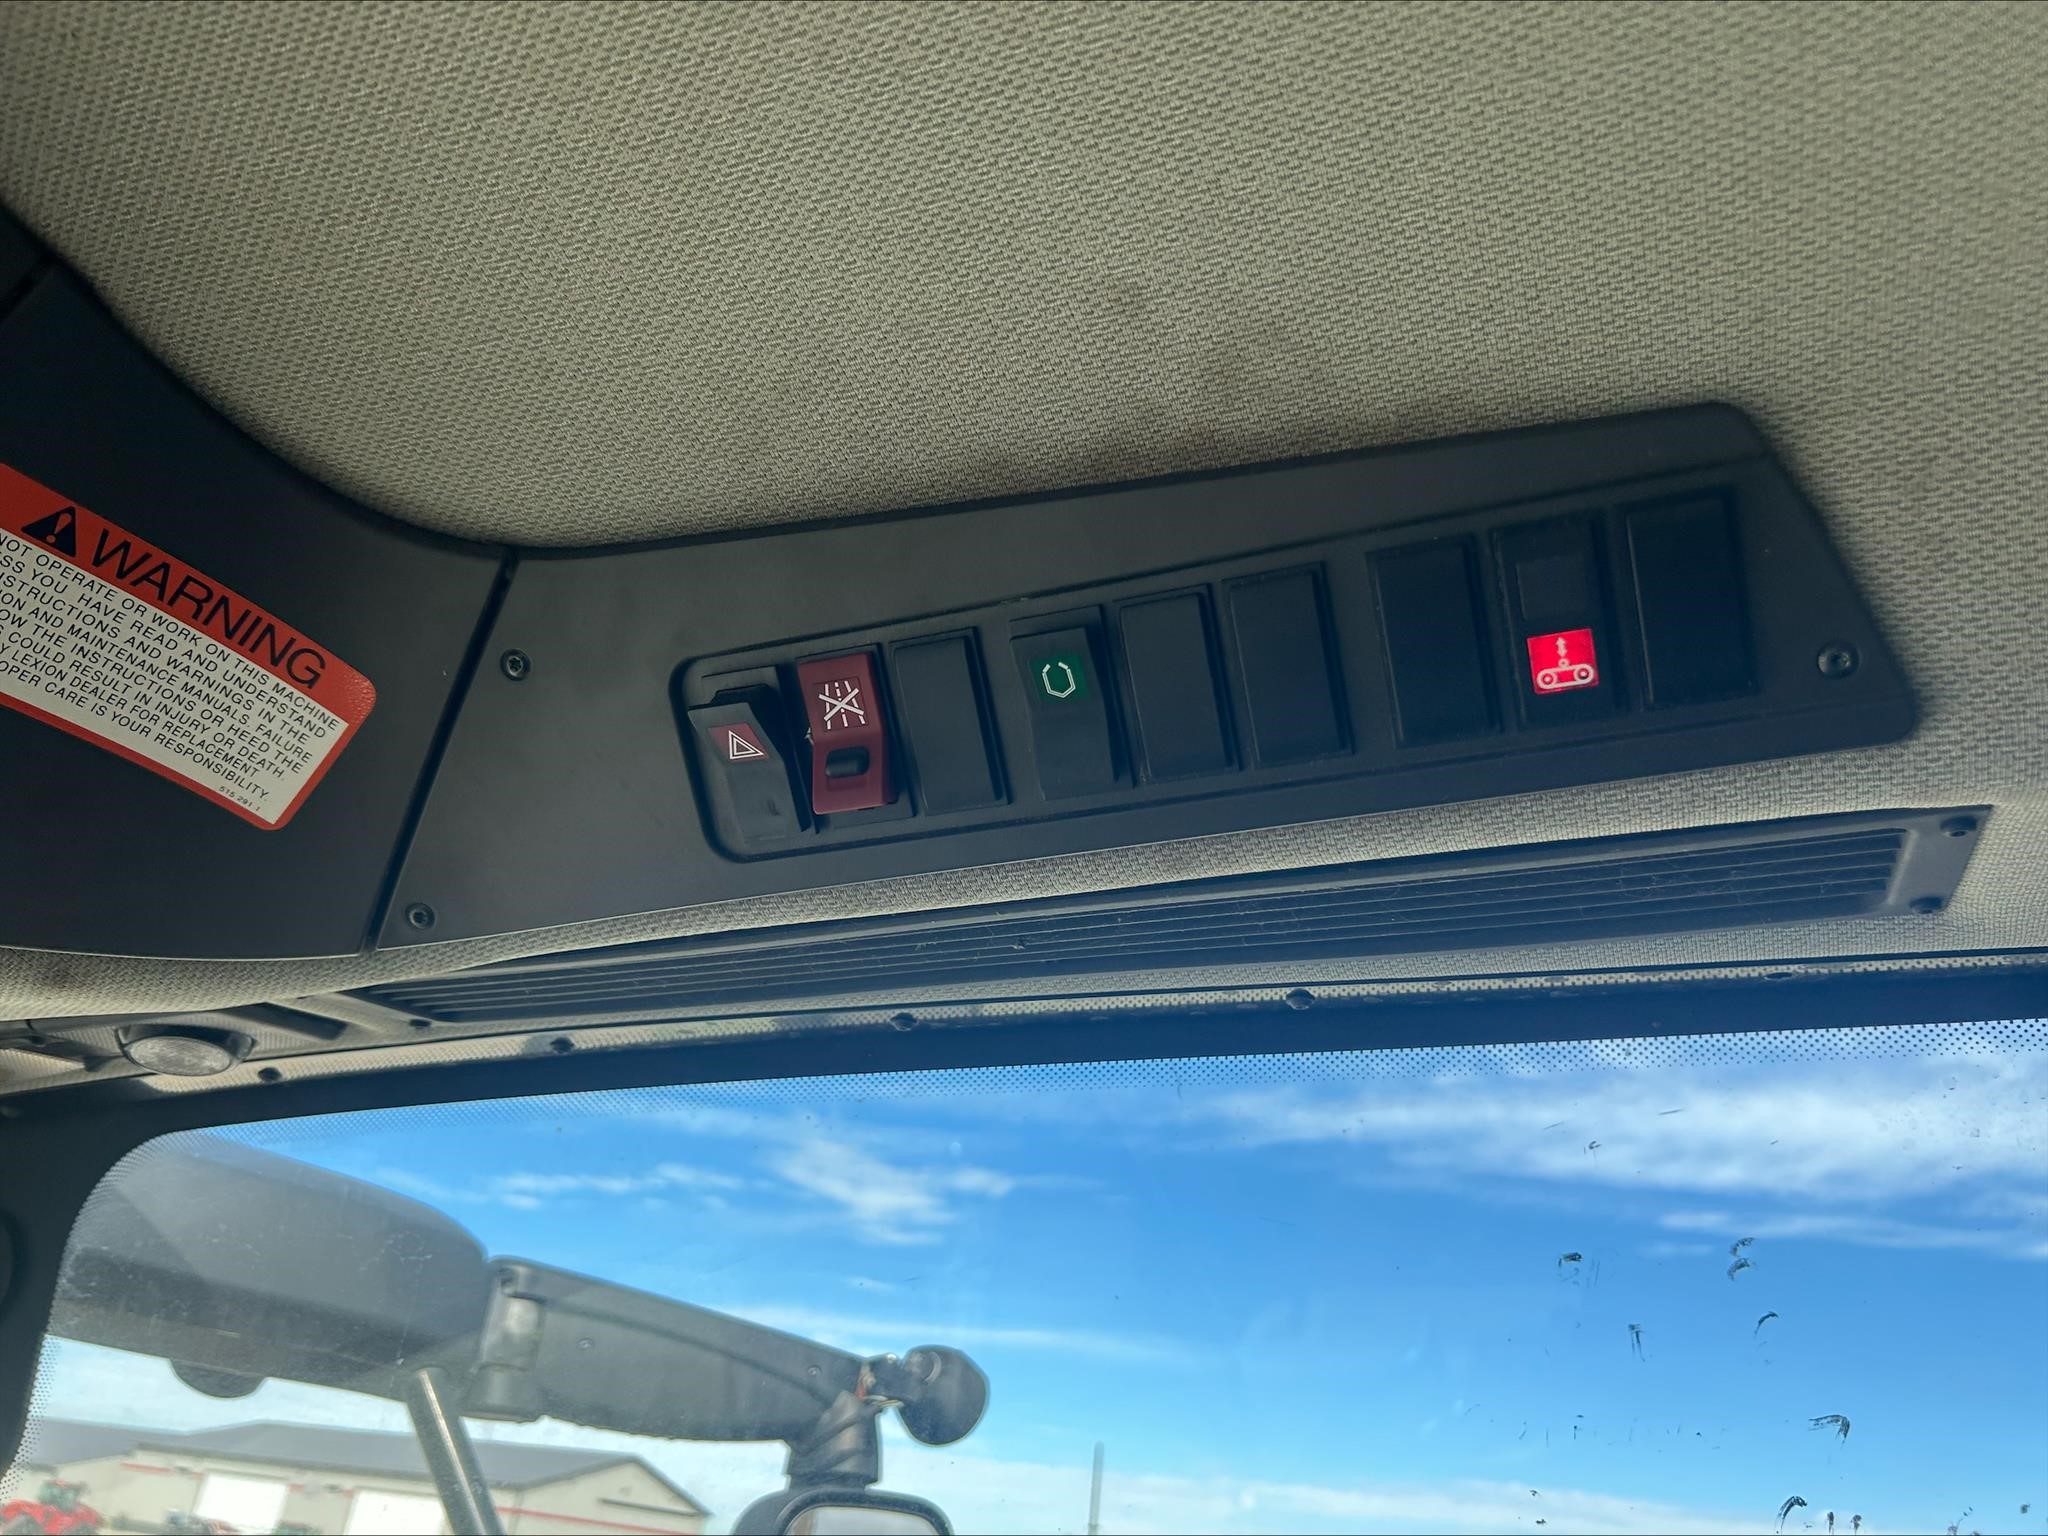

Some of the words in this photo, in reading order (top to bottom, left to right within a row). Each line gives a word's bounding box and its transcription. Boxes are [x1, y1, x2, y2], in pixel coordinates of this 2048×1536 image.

[0, 551, 25, 573] SS
[32, 568, 68, 593] YOU
[77, 593, 127, 624] HAVE
[130, 620, 178, 650] READ
[181, 649, 218, 672] AND
[223, 670, 326, 738] UNDERSTAND
[0, 589, 26, 610] ON
[28, 607, 64, 629] AND
[67, 624, 180, 686] MAINTENANCE
[255, 723, 313, 763] FAILURE
[36, 554, 118, 601] OPERATE
[121, 598, 147, 617] OR
[152, 612, 202, 646] WORK
[205, 643, 230, 662] ON
[234, 658, 270, 685] THIS
[272, 682, 340, 731] MACHINE
[91, 528, 326, 689] WARNING
[8, 631, 65, 663] COULD
[69, 660, 133, 694] RESULT
[134, 691, 153, 705] IN
[155, 701, 211, 734] INJURY
[213, 732, 236, 749] OR
[11, 650, 68, 681] LEXION
[69, 676, 128, 710] DEALER
[129, 704, 160, 725] FOR
[162, 720, 260, 777] REPLACEMENT
[32, 623, 68, 648] THE
[70, 643, 197, 712] INSTRUCTIONS
[200, 709, 225, 727] OR
[227, 723, 270, 753] HEED
[274, 749, 304, 774] THE
[45, 682, 89, 708] CARE
[90, 703, 108, 716] IS
[111, 711, 152, 738] YOUR
[124, 636, 162, 659] AND
[167, 656, 255, 710] WARNINGS
[258, 708, 276, 723] IN
[280, 720, 311, 745] THE
